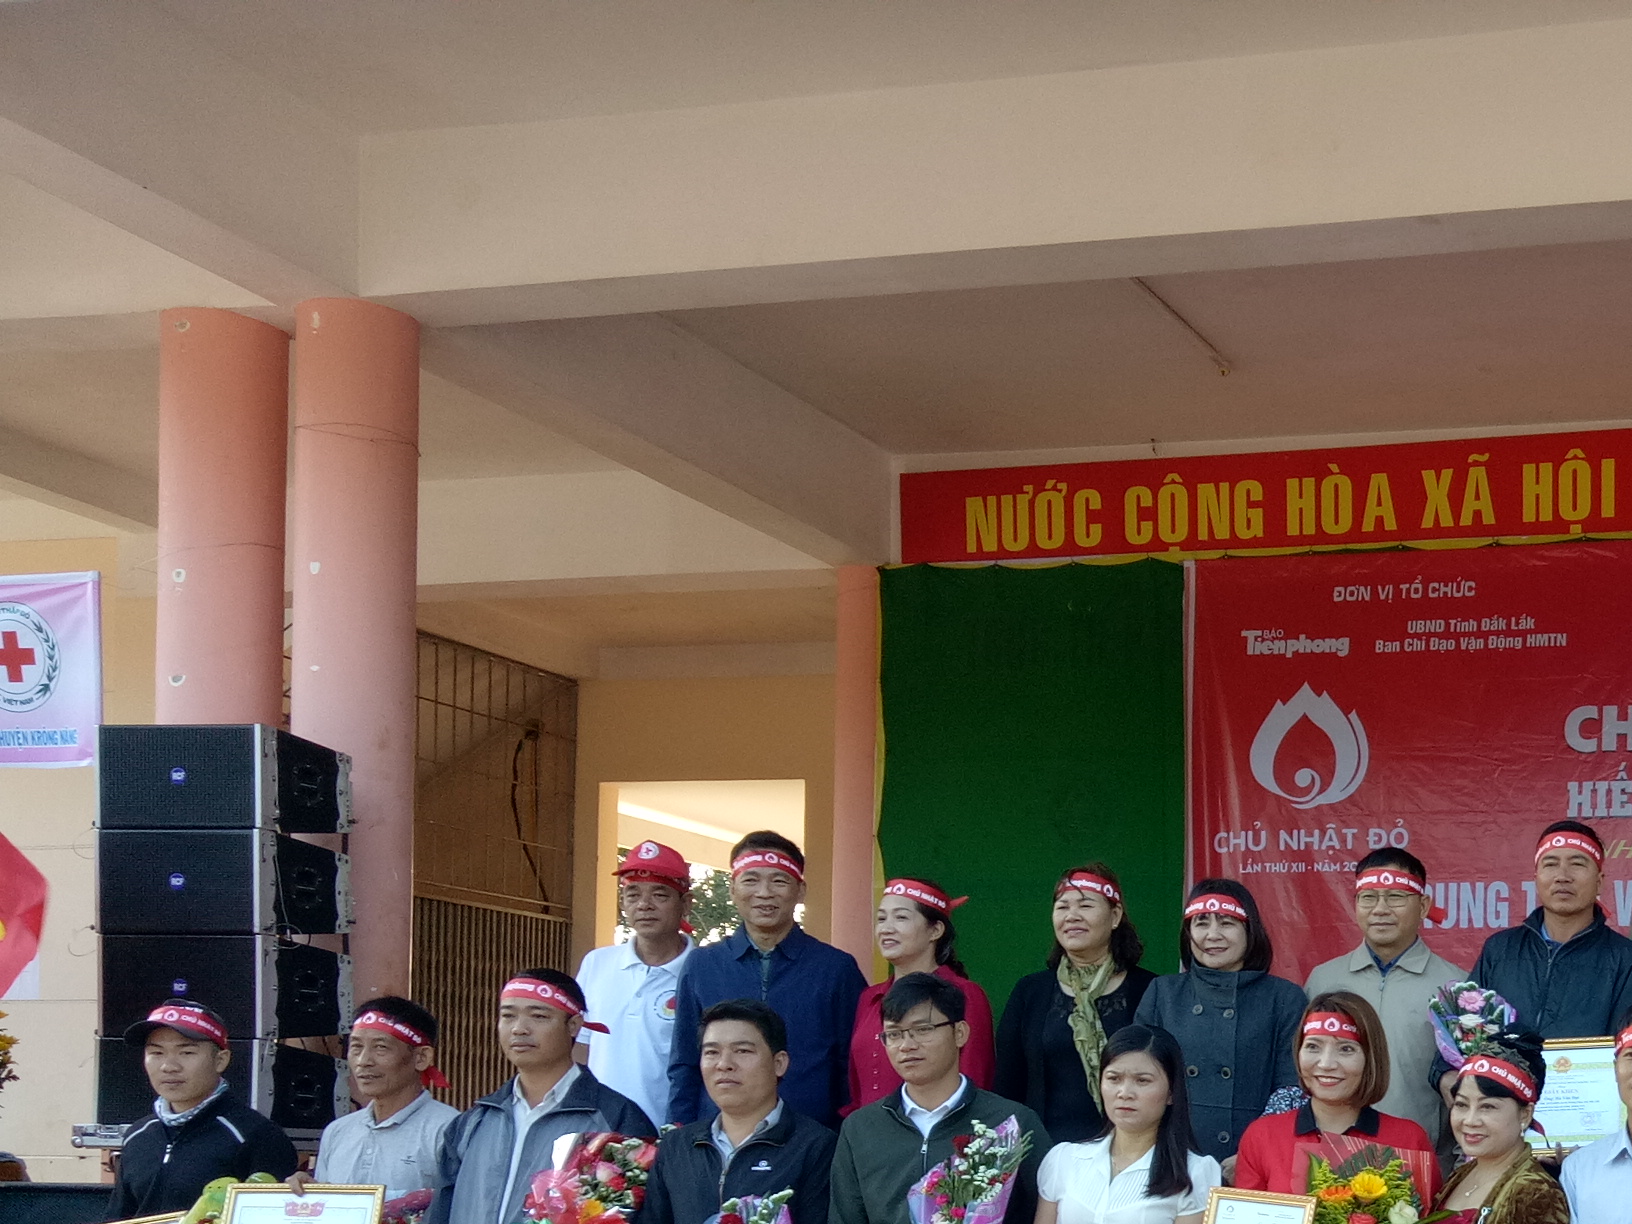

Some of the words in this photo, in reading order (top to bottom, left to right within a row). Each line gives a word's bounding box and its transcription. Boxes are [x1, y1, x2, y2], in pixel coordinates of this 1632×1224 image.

[965, 480, 1101, 553] NƯỚC
[1124, 473, 1264, 552] CỘNG
[1286, 463, 1397, 537] HÒA
[1420, 452, 1496, 528] XÃ
[1522, 448, 1616, 533] HỘI
[1333, 585, 1371, 602] ĐƠN
[1377, 583, 1394, 603] VỊ
[1399, 574, 1423, 600] TỔ
[1428, 576, 1477, 598] CHỨC
[1406, 619, 1446, 634] UBND
[1375, 640, 1401, 653] Ban
[1428, 636, 1456, 653] Đạo
[1459, 635, 1485, 653] Vận
[1487, 633, 1523, 652] Động
[1525, 633, 1567, 647] HMTN
[1213, 820, 1266, 854] CHỦ
[1278, 822, 1359, 856] NHẬT
[1366, 818, 1409, 850] ĐỎ
[1264, 860, 1289, 873] THỨ
[1290, 862, 1305, 873] XII
[1314, 859, 1341, 873] NĂM
[1491, 1066, 1508, 1080] CHỦ
[1506, 1073, 1527, 1091] NHẬT
[1522, 1083, 1533, 1098] ĐỎ
